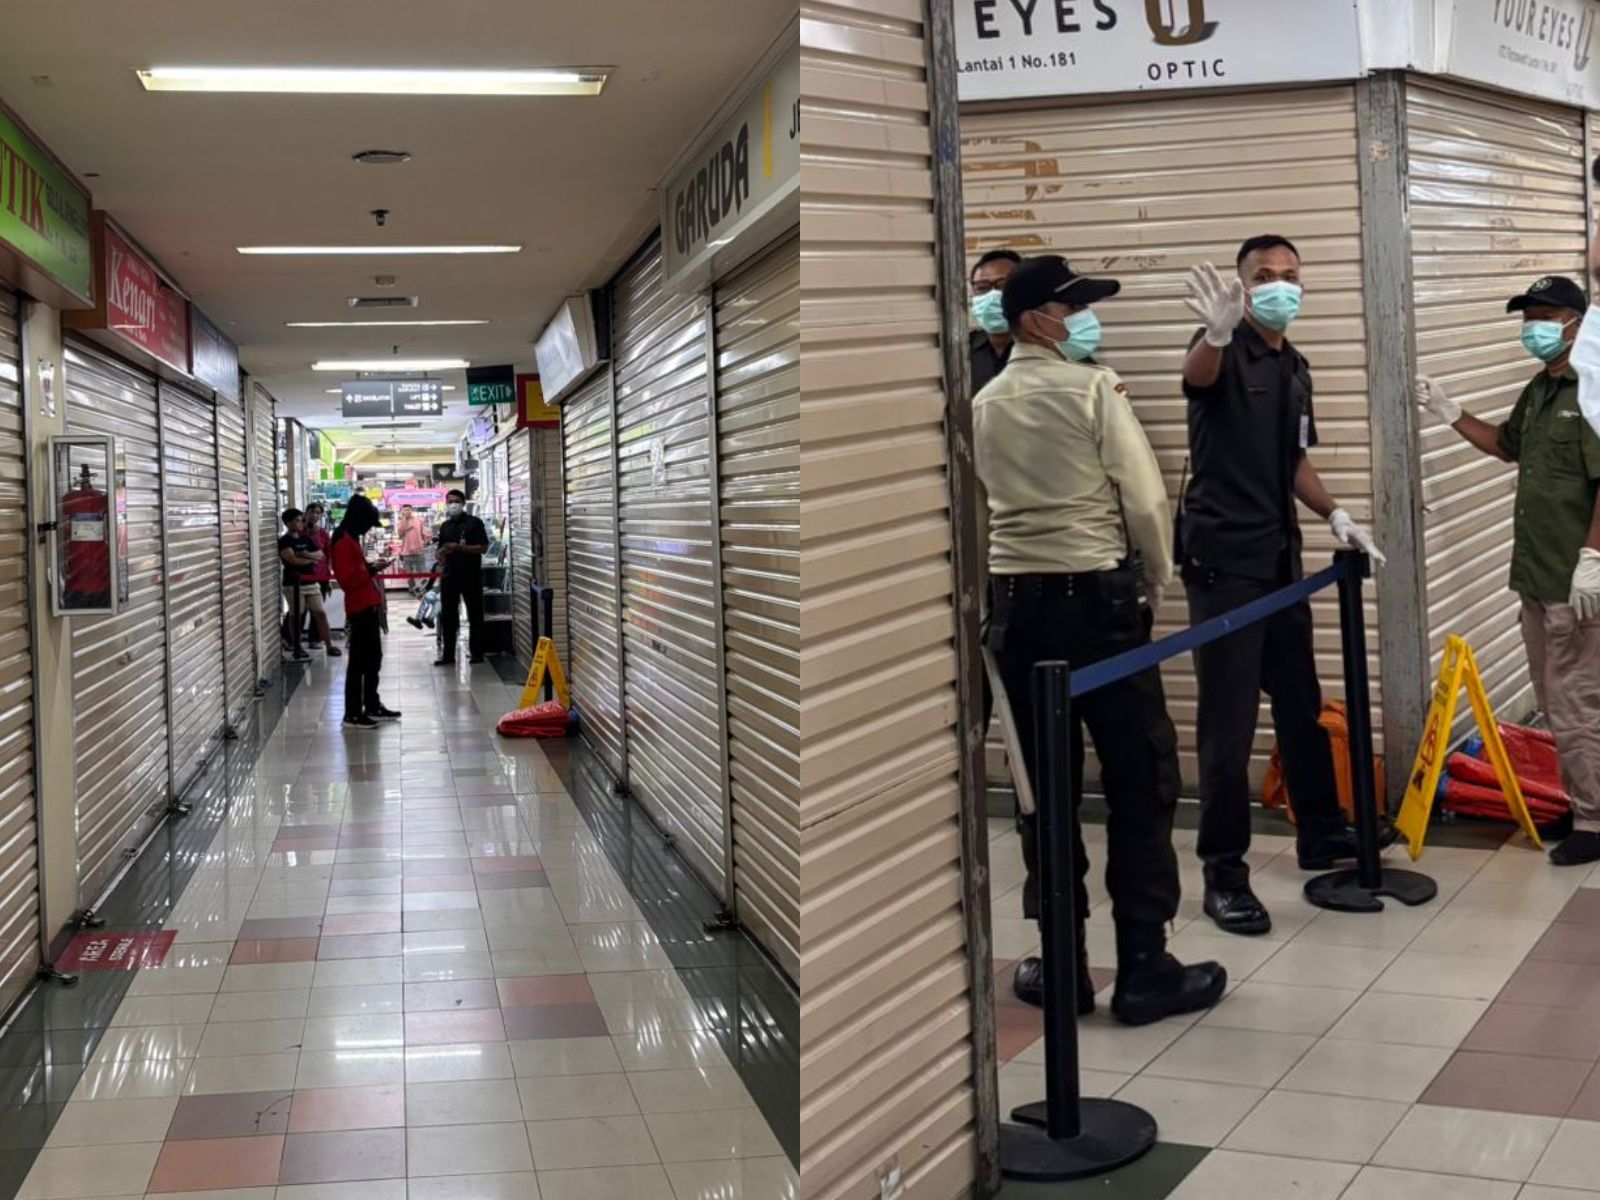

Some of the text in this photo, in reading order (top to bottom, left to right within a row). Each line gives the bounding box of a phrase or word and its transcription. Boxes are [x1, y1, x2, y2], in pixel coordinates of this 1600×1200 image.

[973, 0, 1118, 39] EYES
[1539, 5, 1575, 50] EYES
[956, 56, 1003, 73] Lantai
[1009, 55, 1016, 70] 1
[1147, 58, 1226, 80] OPTIC
[674, 121, 749, 256] GARUDA
[480, 384, 504, 402] EXIT
